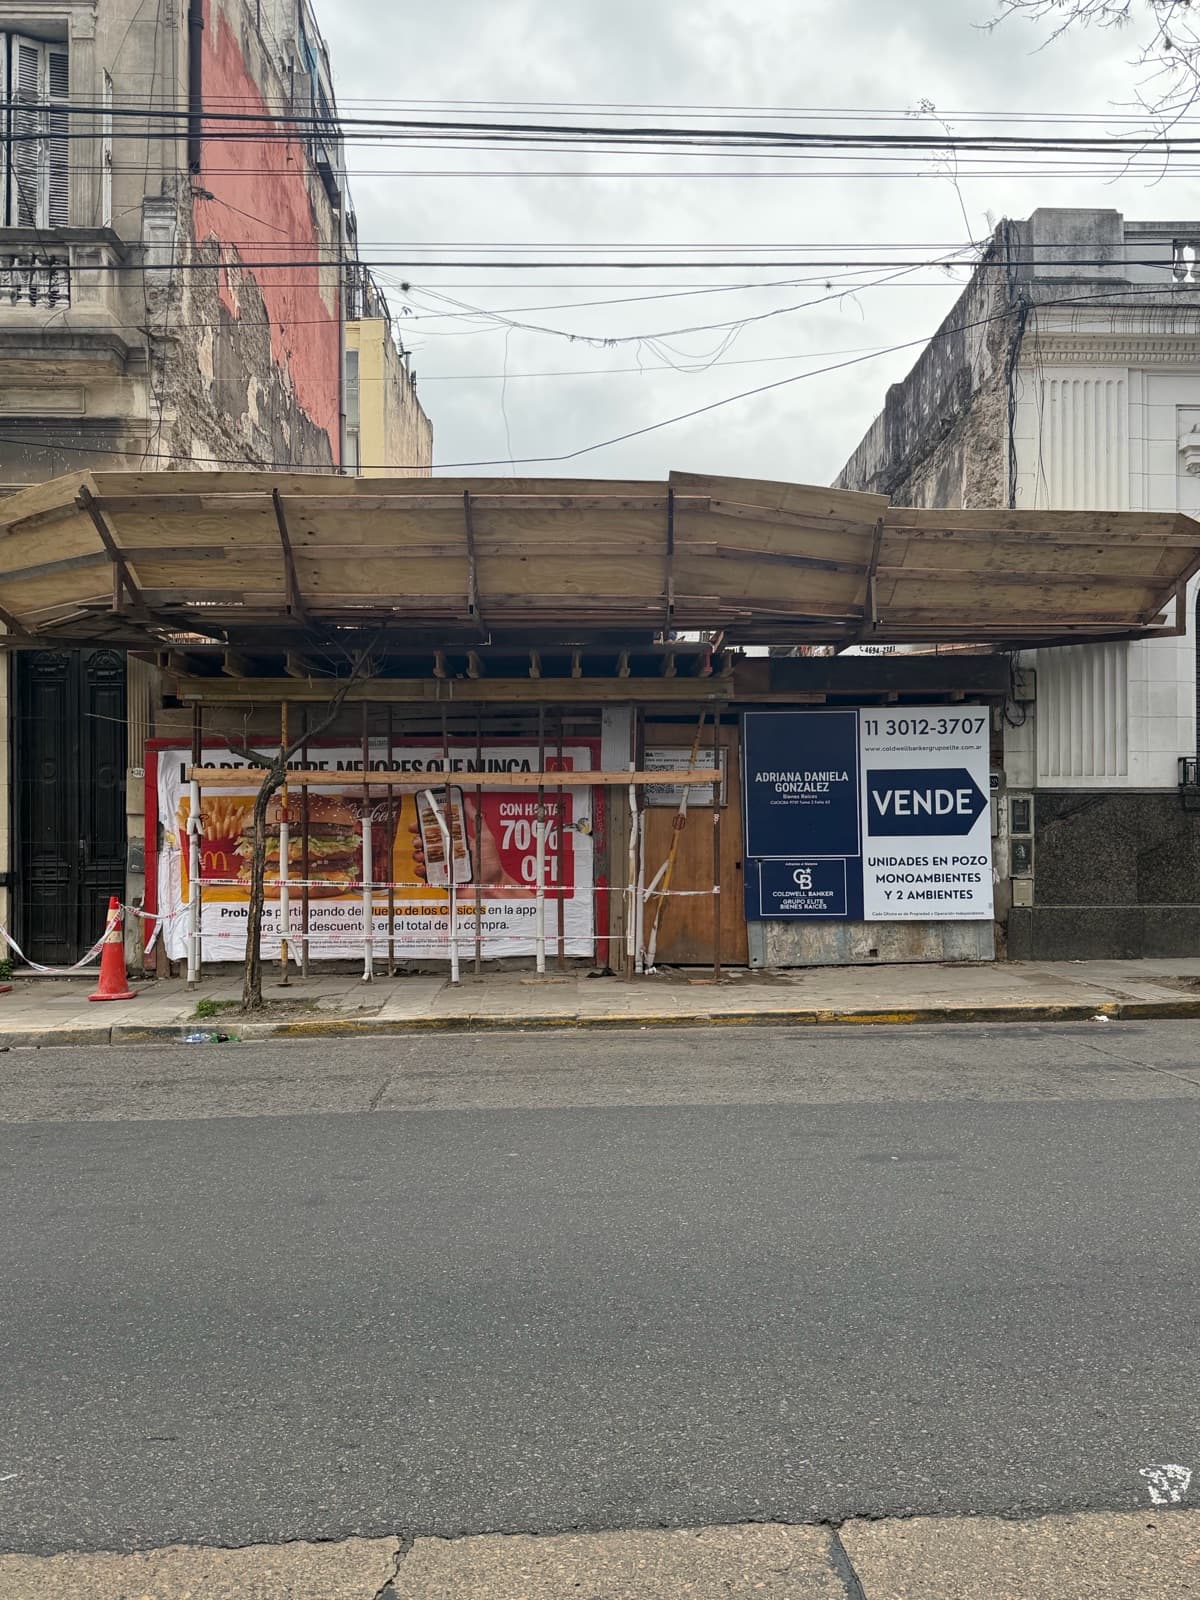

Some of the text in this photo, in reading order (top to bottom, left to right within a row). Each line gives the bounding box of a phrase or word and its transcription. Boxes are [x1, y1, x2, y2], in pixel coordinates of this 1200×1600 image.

[864, 718, 986, 736] 11 3012-3707
[755, 771, 849, 783] ADRIANA DANIELA
[775, 782, 829, 792] GONZALEZ
[872, 789, 973, 816] VENDE
[500, 803, 522, 816] CON
[500, 820, 558, 850] 70%
[868, 856, 988, 867] UNIDADES EN POZO
[876, 873, 981, 883] MONOAMBIENTES
[884, 890, 973, 900] Y 2 AMBIENTES
[221, 905, 537, 919] Probos prtipando del ueo de los Csics en la app
[276, 923, 304, 934] gna
[310, 922, 375, 932] descuents
[394, 921, 404, 930] el
[407, 921, 432, 931] total
[434, 920, 448, 930] de
[464, 921, 510, 932] compra.
